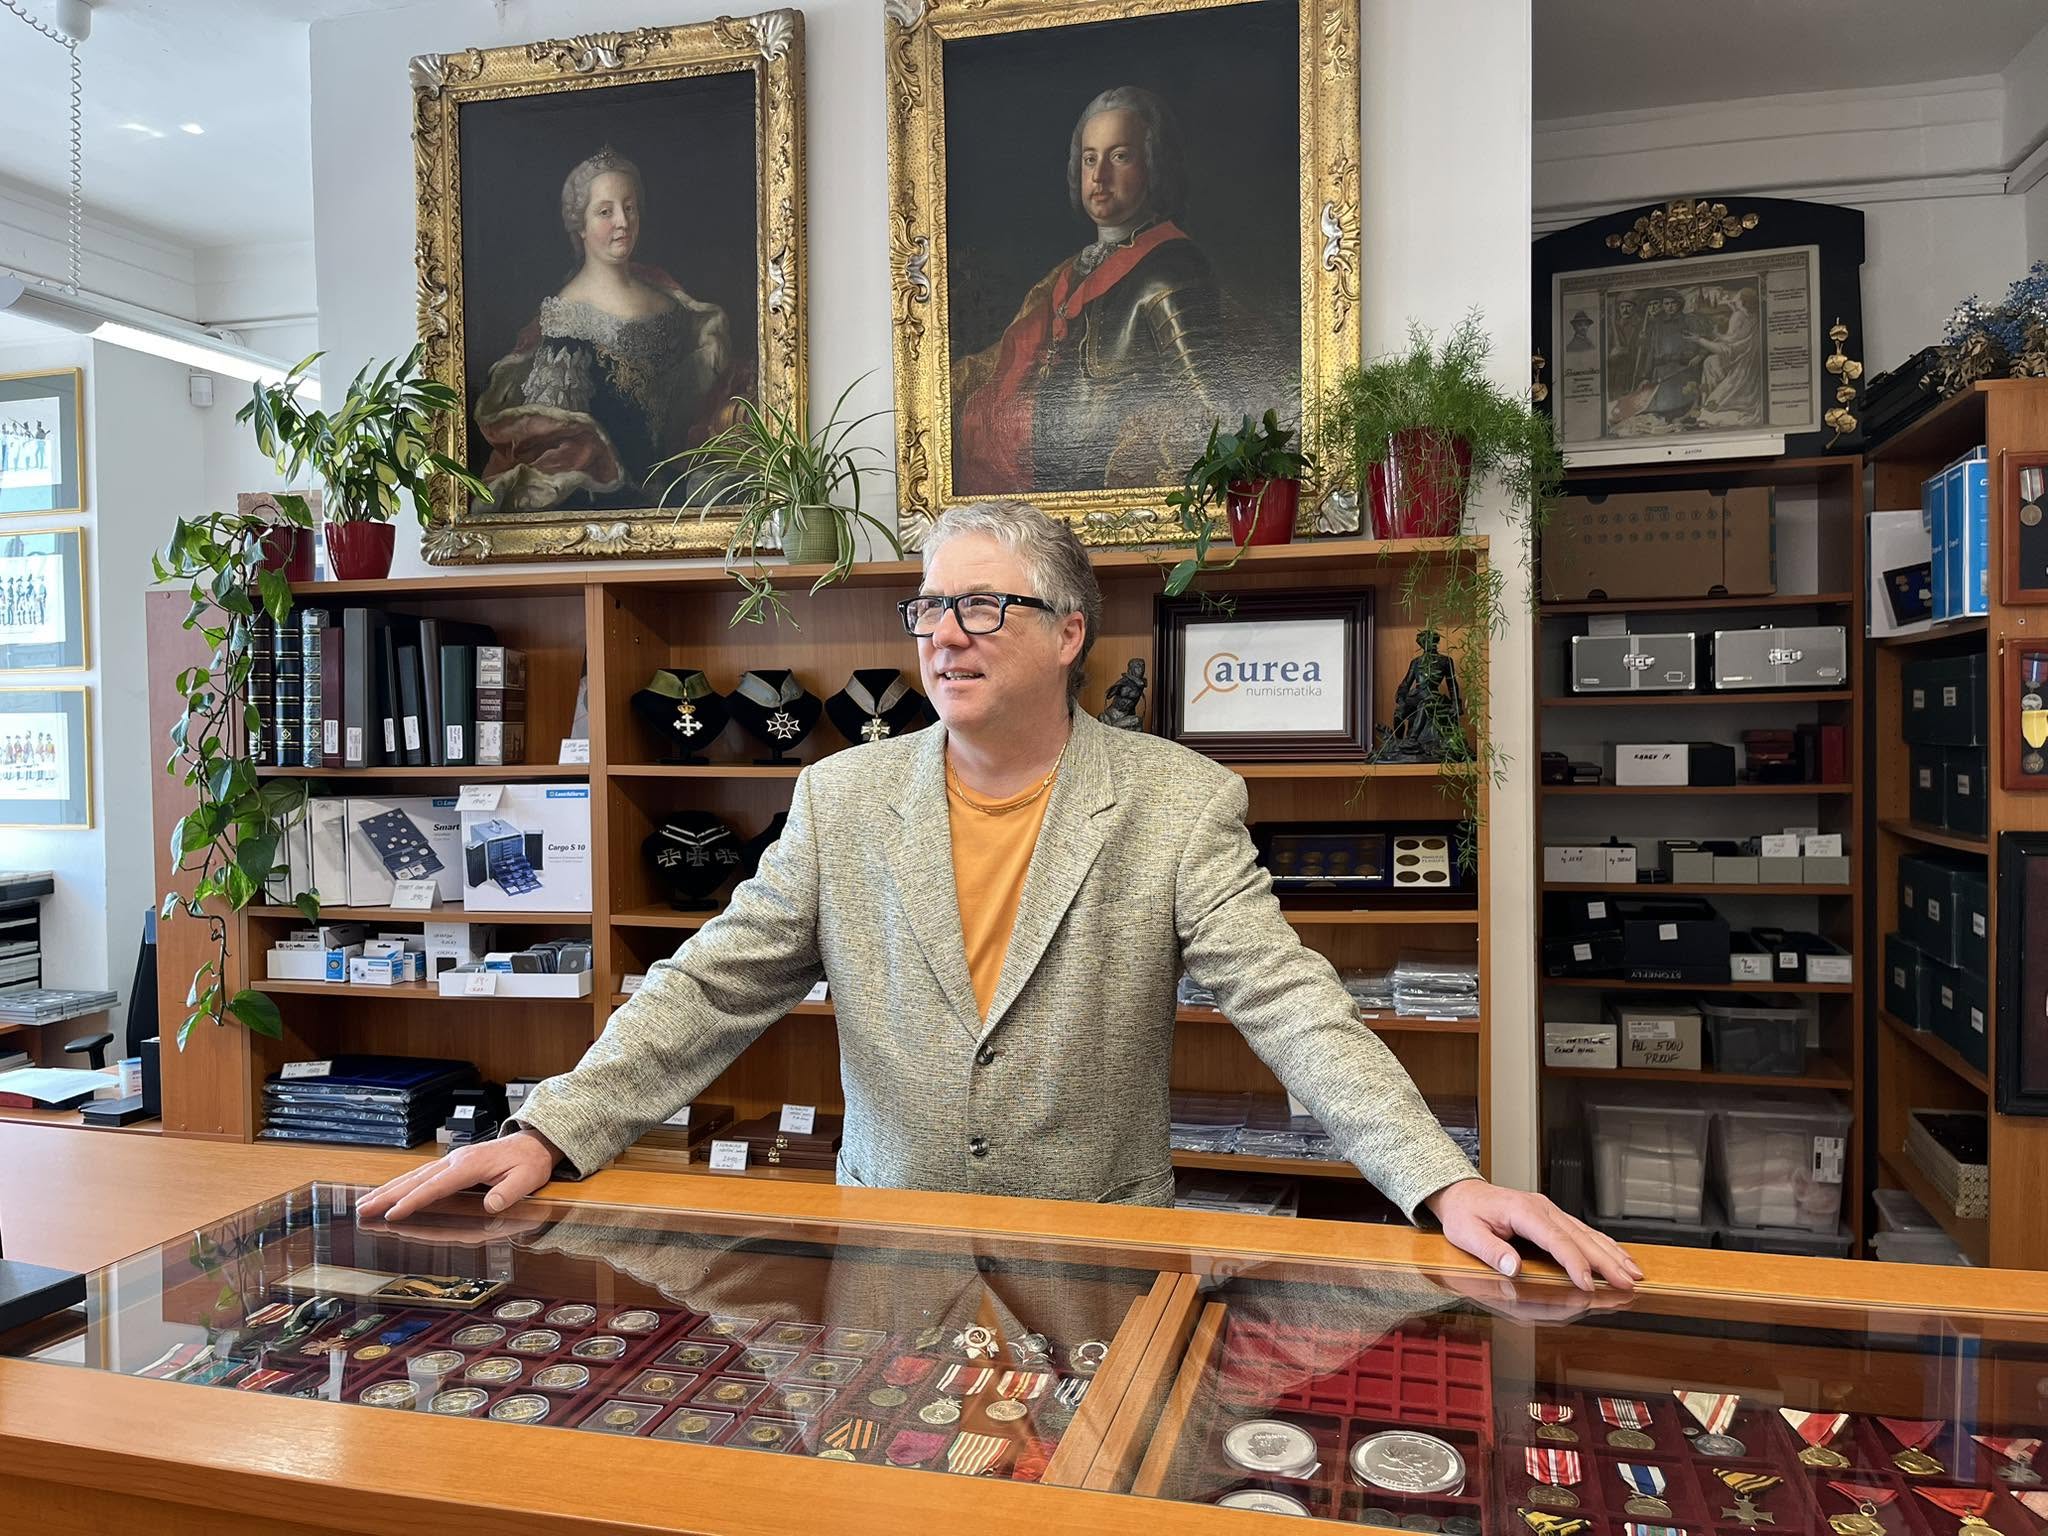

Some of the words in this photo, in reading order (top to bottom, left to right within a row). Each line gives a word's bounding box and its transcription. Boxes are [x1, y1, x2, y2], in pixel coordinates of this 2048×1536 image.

[1215, 660, 1322, 682] aurea
[1246, 684, 1322, 697] numismatika
[433, 823, 460, 832] Smart
[548, 843, 569, 852] Cargo
[570, 843, 576, 851] S
[577, 843, 586, 851] 10
[1644, 1052, 1681, 1065] PROOF
